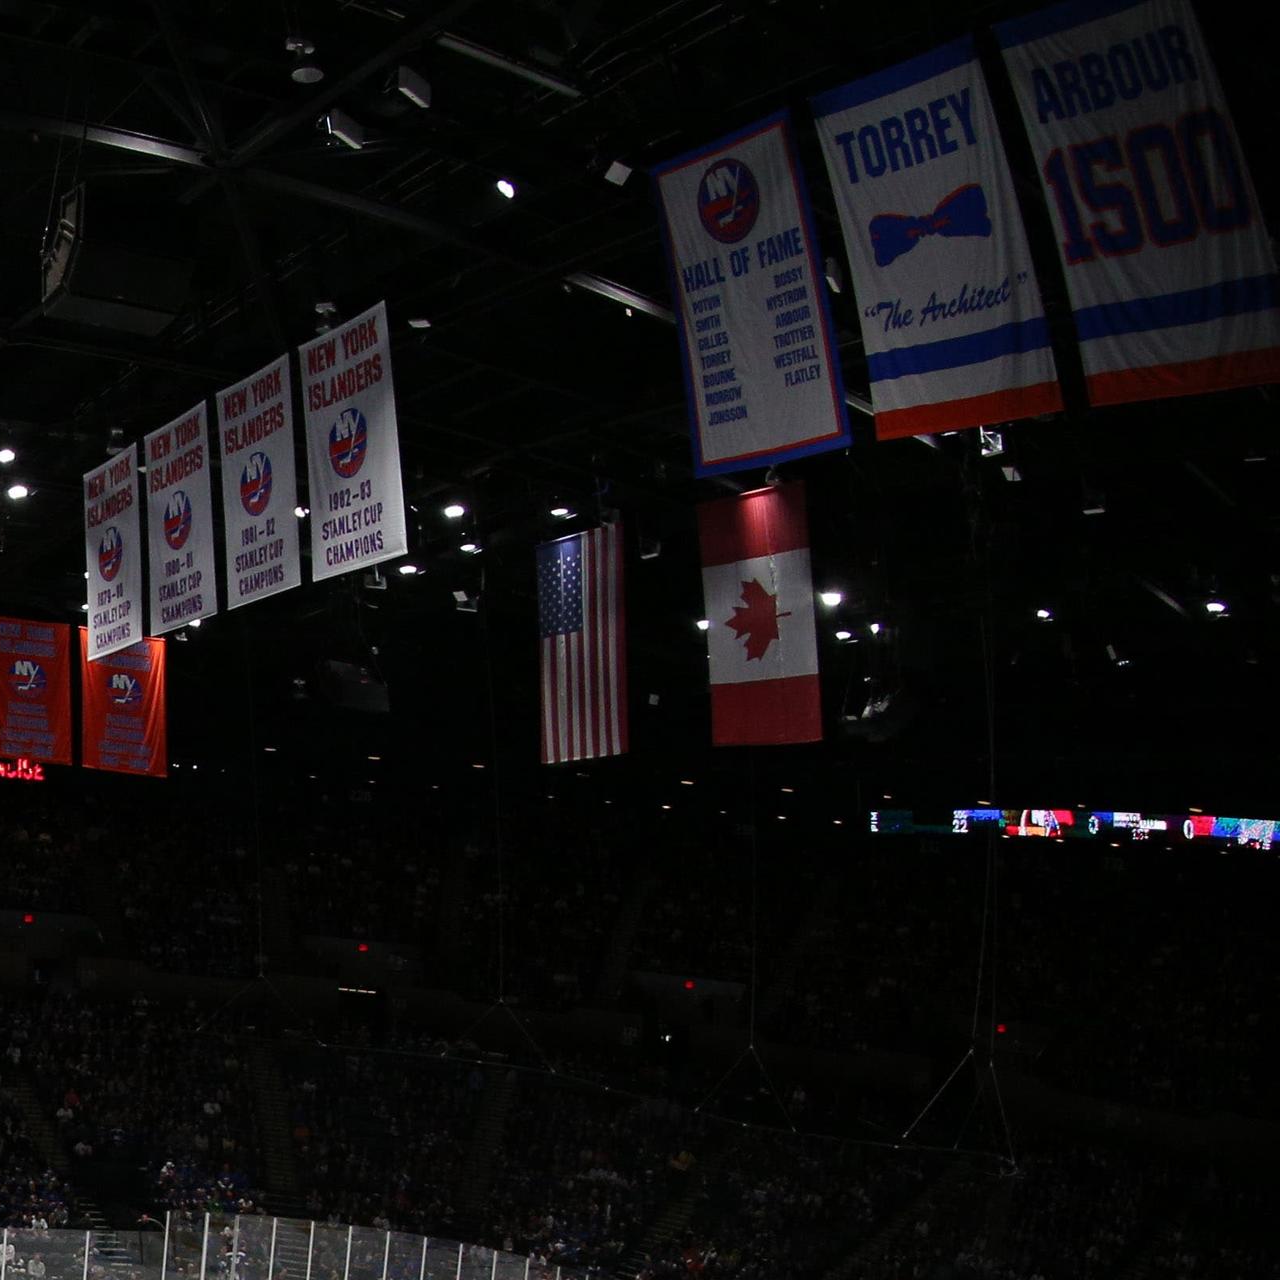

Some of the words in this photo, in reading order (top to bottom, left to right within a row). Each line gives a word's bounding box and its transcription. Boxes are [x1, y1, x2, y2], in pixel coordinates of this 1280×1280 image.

[1030, 24, 1198, 124] ARBOUR
[835, 88, 977, 185] TORREY
[1043, 107, 1257, 266] 1500
[683, 258, 726, 293] HALL
[729, 247, 750, 278] OF
[757, 227, 803, 269] FAME
[773, 266, 803, 288] BOSSY
[692, 295, 721, 315] POTVIN
[766, 286, 807, 311] NYSTROM
[696, 315, 720, 333] SMITH
[775, 306, 811, 329] ARBOUR
[307, 340, 338, 376] NEW
[339, 315, 379, 359] YORK
[698, 332, 729, 352] GILLIES
[773, 325, 815, 350] TROTTIER
[701, 350, 731, 370] TORREY
[773, 345, 818, 369] WESTFALL
[307, 355, 383, 412] ISLANDERS
[703, 368, 736, 389] BOURNE
[784, 364, 821, 387] FLATLEY
[224, 388, 249, 420] NEW
[251, 368, 282, 402] YORK
[150, 430, 173, 462] NEW
[175, 412, 200, 445] YORK
[224, 402, 285, 455] ISLANDERS
[88, 470, 107, 499] NEW
[108, 458, 132, 486] YORK
[150, 445, 203, 493] ISLANDERS
[88, 485, 133, 529] ISLANDERS
[322, 511, 363, 540] STANLEY
[363, 504, 383, 527] CUP
[235, 543, 267, 574] STANLEY
[268, 538, 285, 563] CUP
[325, 531, 384, 566] CHAMPIONS
[159, 576, 187, 603] STANLEY
[188, 571, 203, 593] CUP
[239, 566, 284, 596] CHAMPIONS
[93, 603, 118, 630] STANLEY
[161, 598, 203, 625] CHAMPIONS
[96, 623, 131, 650] CHAMPIONS
[870, 811, 878, 832] PIM
